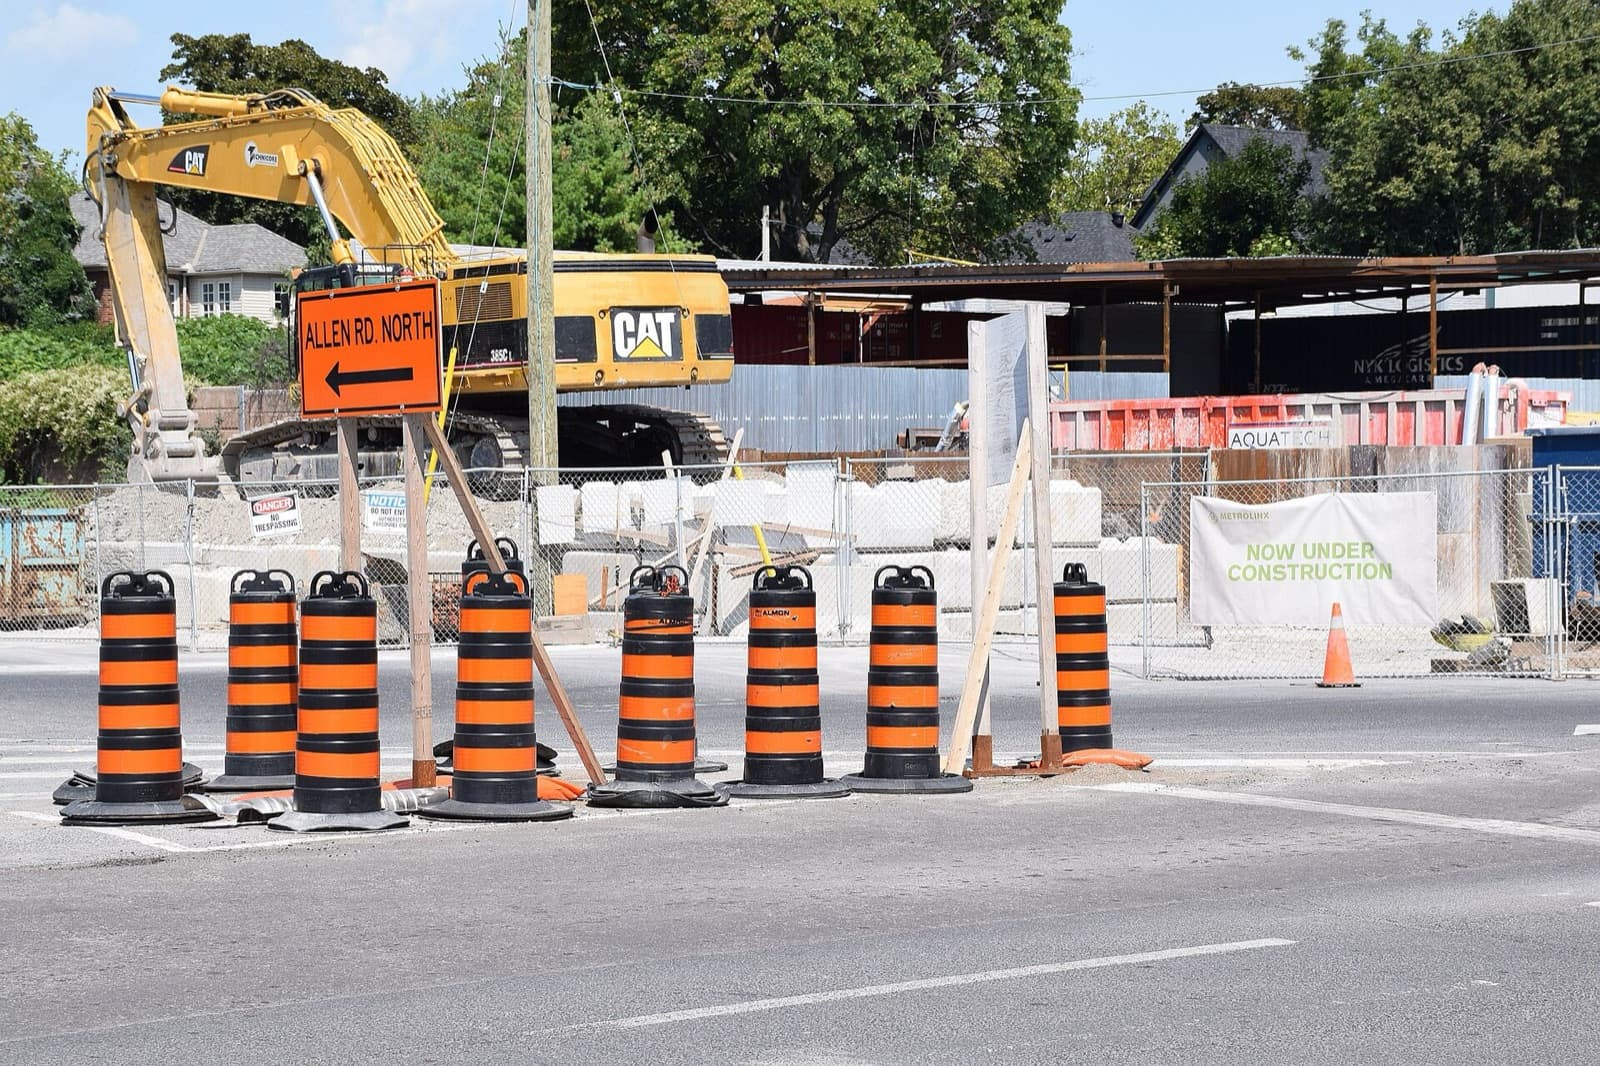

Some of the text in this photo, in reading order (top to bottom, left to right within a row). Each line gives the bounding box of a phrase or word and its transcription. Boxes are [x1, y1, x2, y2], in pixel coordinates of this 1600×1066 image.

[185, 151, 205, 175] CAT
[305, 310, 433, 350] ALLEN RD. NORTH
[613, 312, 675, 358] CAT
[1353, 360, 1384, 374] NYK
[255, 498, 291, 512] DANGER
[370, 495, 406, 507] NOTIC
[270, 513, 280, 521] NO
[1220, 511, 1270, 520] METROLINX
[255, 518, 298, 533] TRESPASSING
[1246, 542, 1375, 561] NOW UNDER
[1227, 562, 1393, 582] CONSTRUCTION
